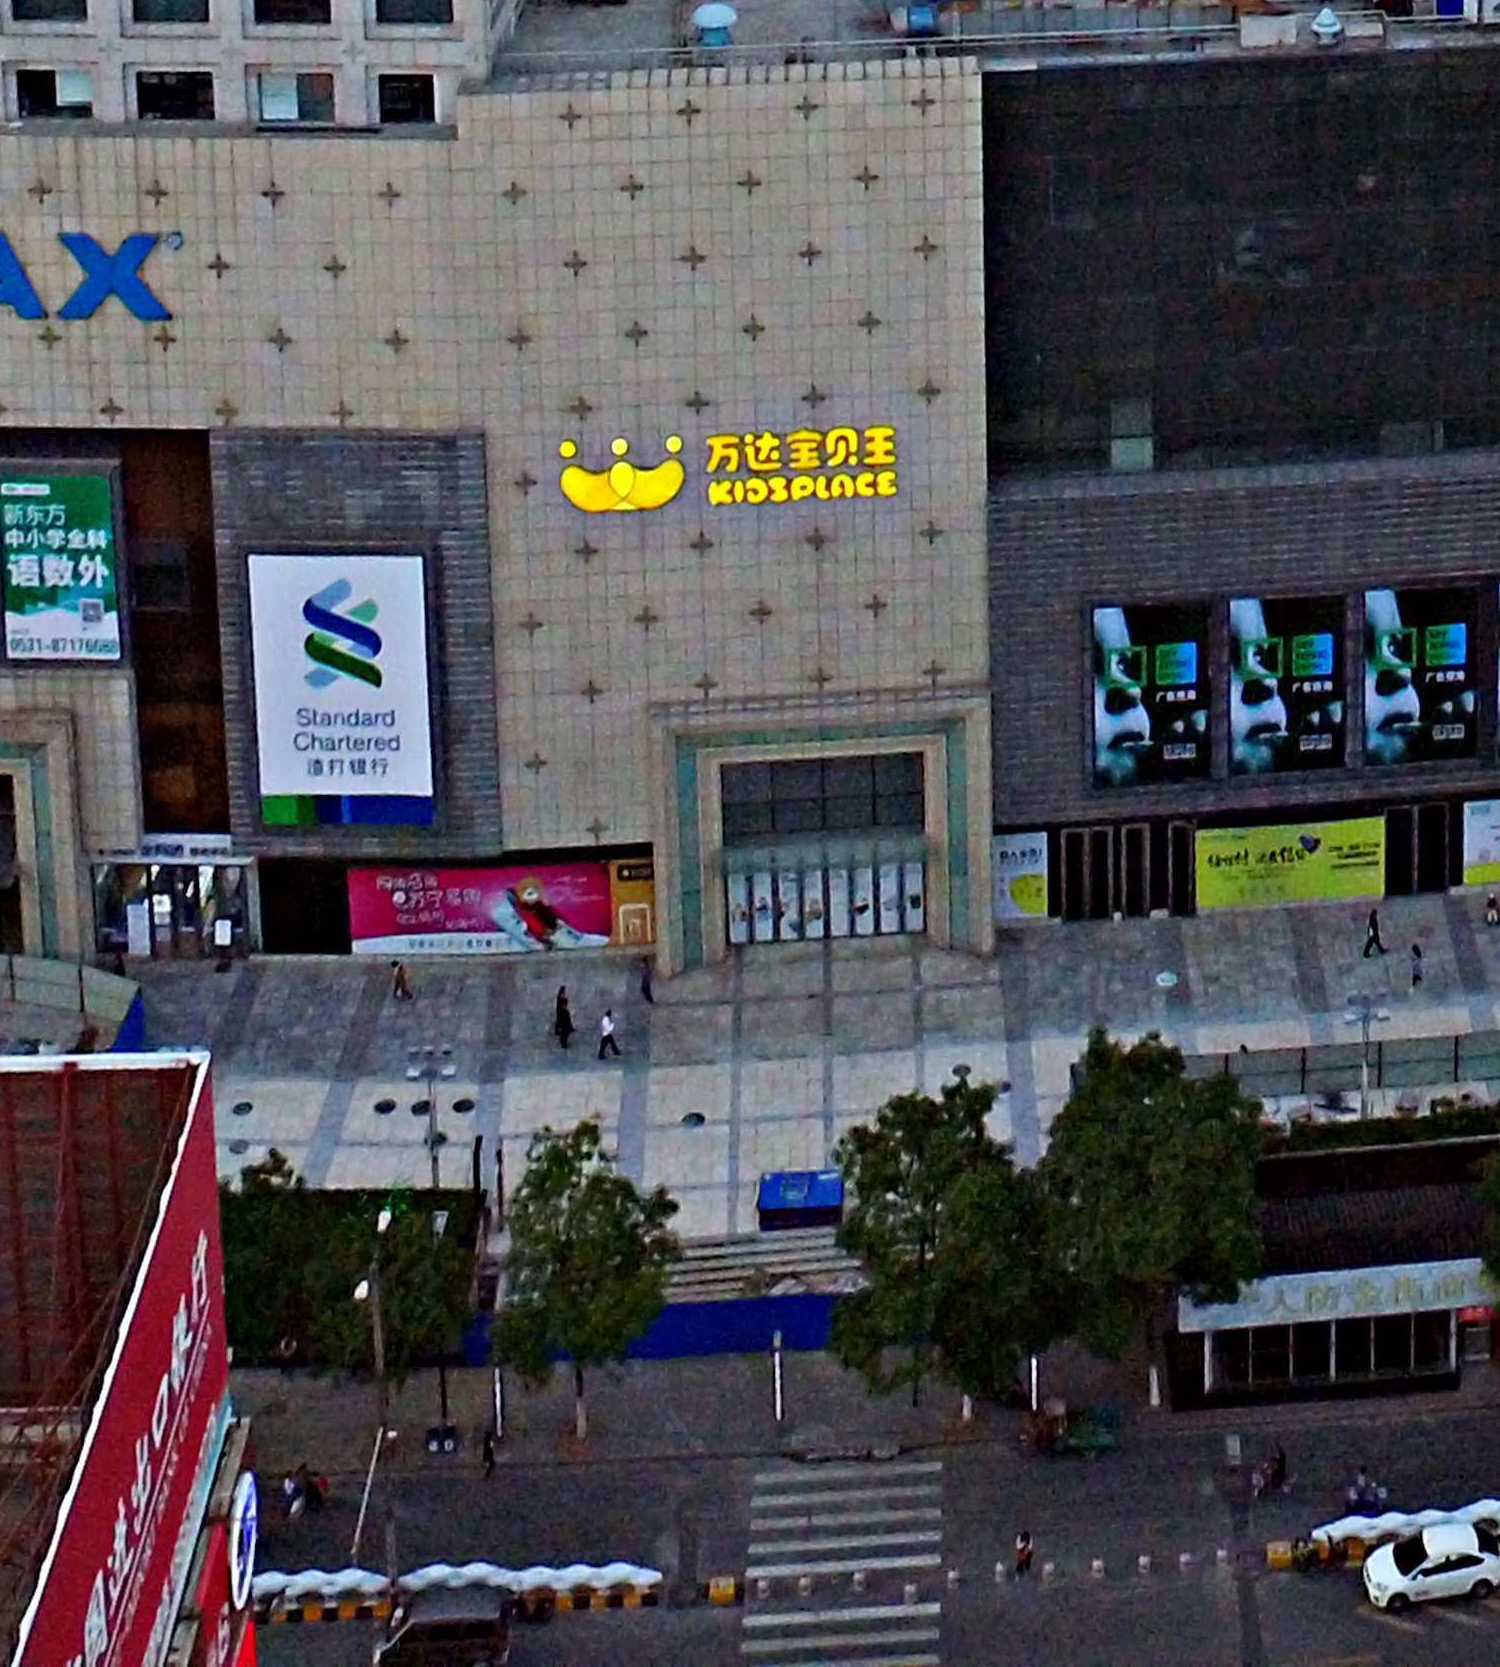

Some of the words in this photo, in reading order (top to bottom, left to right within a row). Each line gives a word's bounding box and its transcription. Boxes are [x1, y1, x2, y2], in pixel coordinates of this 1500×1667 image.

[705, 424, 897, 473] 万达宝贝王
[707, 469, 898, 506] KIDSPLACE
[3, 503, 65, 526] 新东方
[4, 528, 108, 551] 中小学全科
[8, 554, 110, 588] 语数外
[296, 707, 396, 728] Standard
[293, 731, 401, 752] Chartered
[307, 758, 388, 777] 渣打银行
[70, 1229, 208, 1667] 国进出口银行
